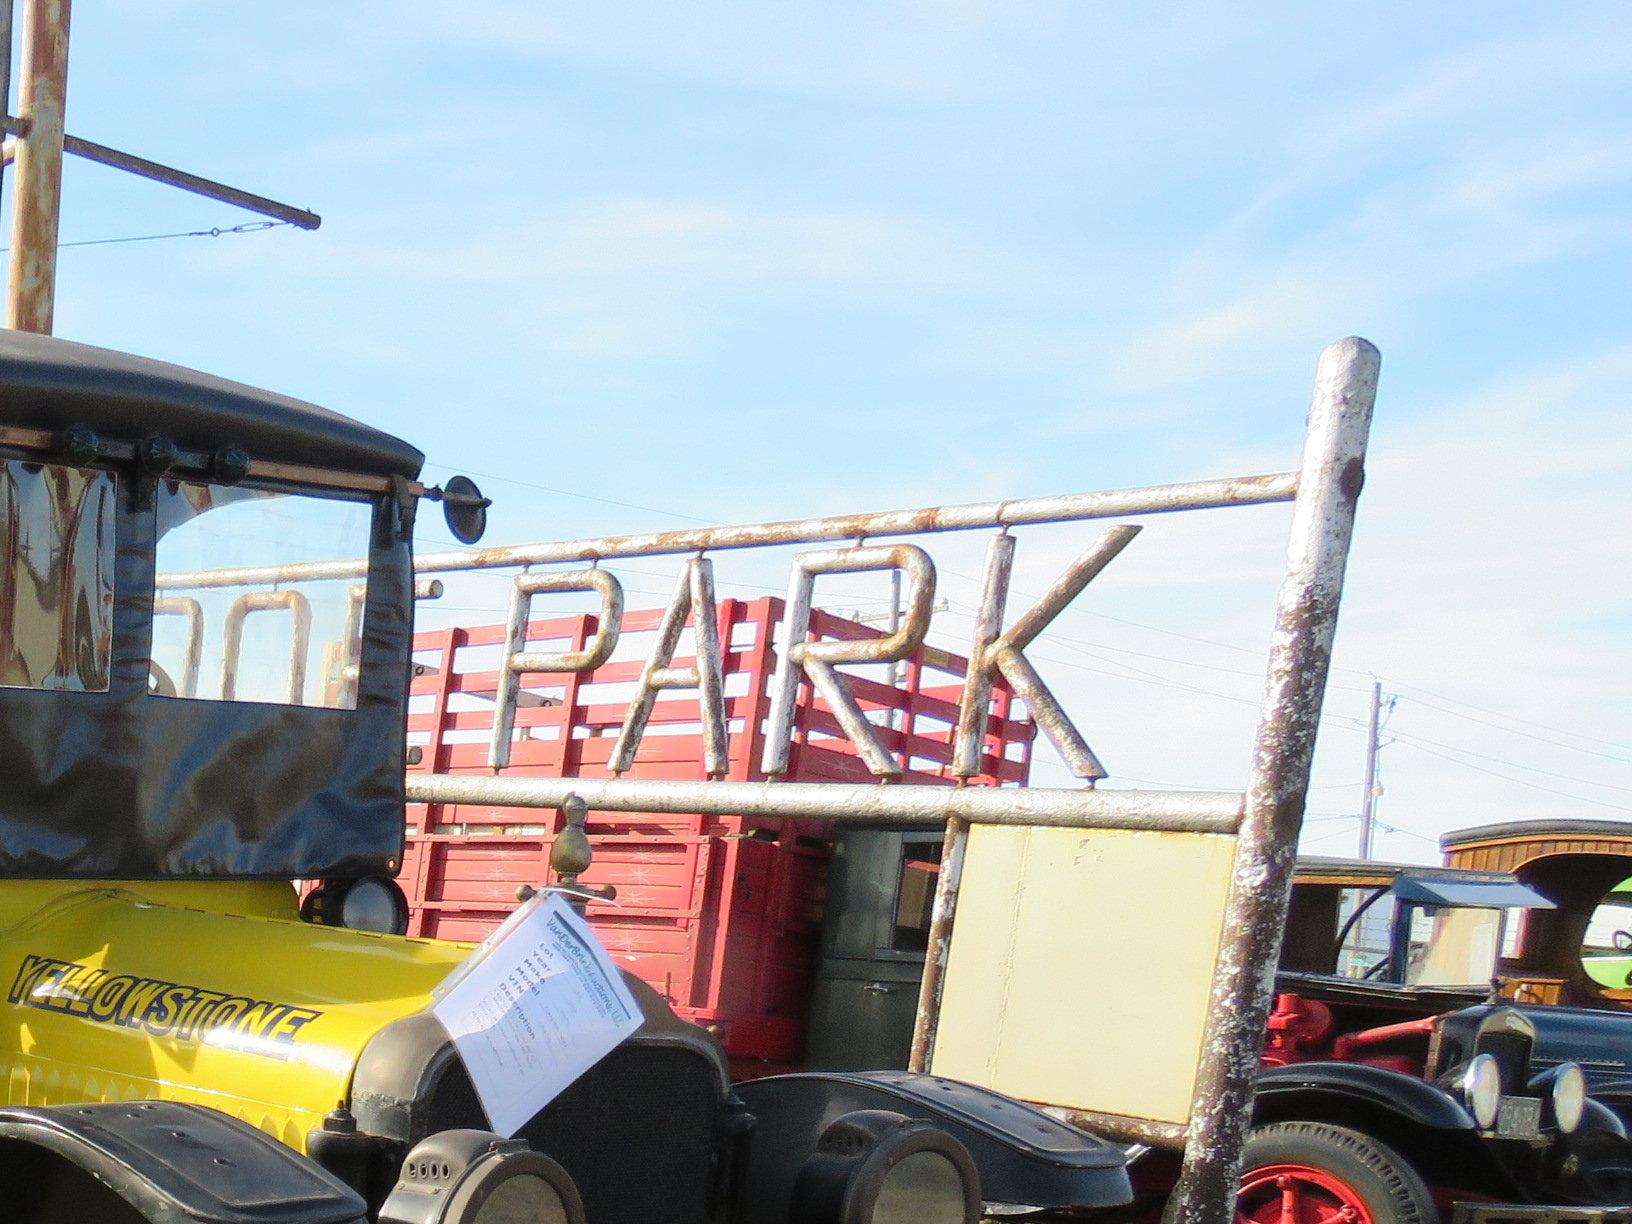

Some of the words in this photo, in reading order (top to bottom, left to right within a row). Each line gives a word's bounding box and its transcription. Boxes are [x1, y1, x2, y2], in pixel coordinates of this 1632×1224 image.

[487, 524, 1143, 779] PARK
[532, 951, 551, 972] Year
[539, 943, 553, 959] Lot
[508, 974, 524, 994] VIN
[515, 967, 540, 996] Model
[524, 959, 546, 985] Make
[8, 954, 325, 1062] YELLOWSTONE
[499, 982, 536, 1040] Description
